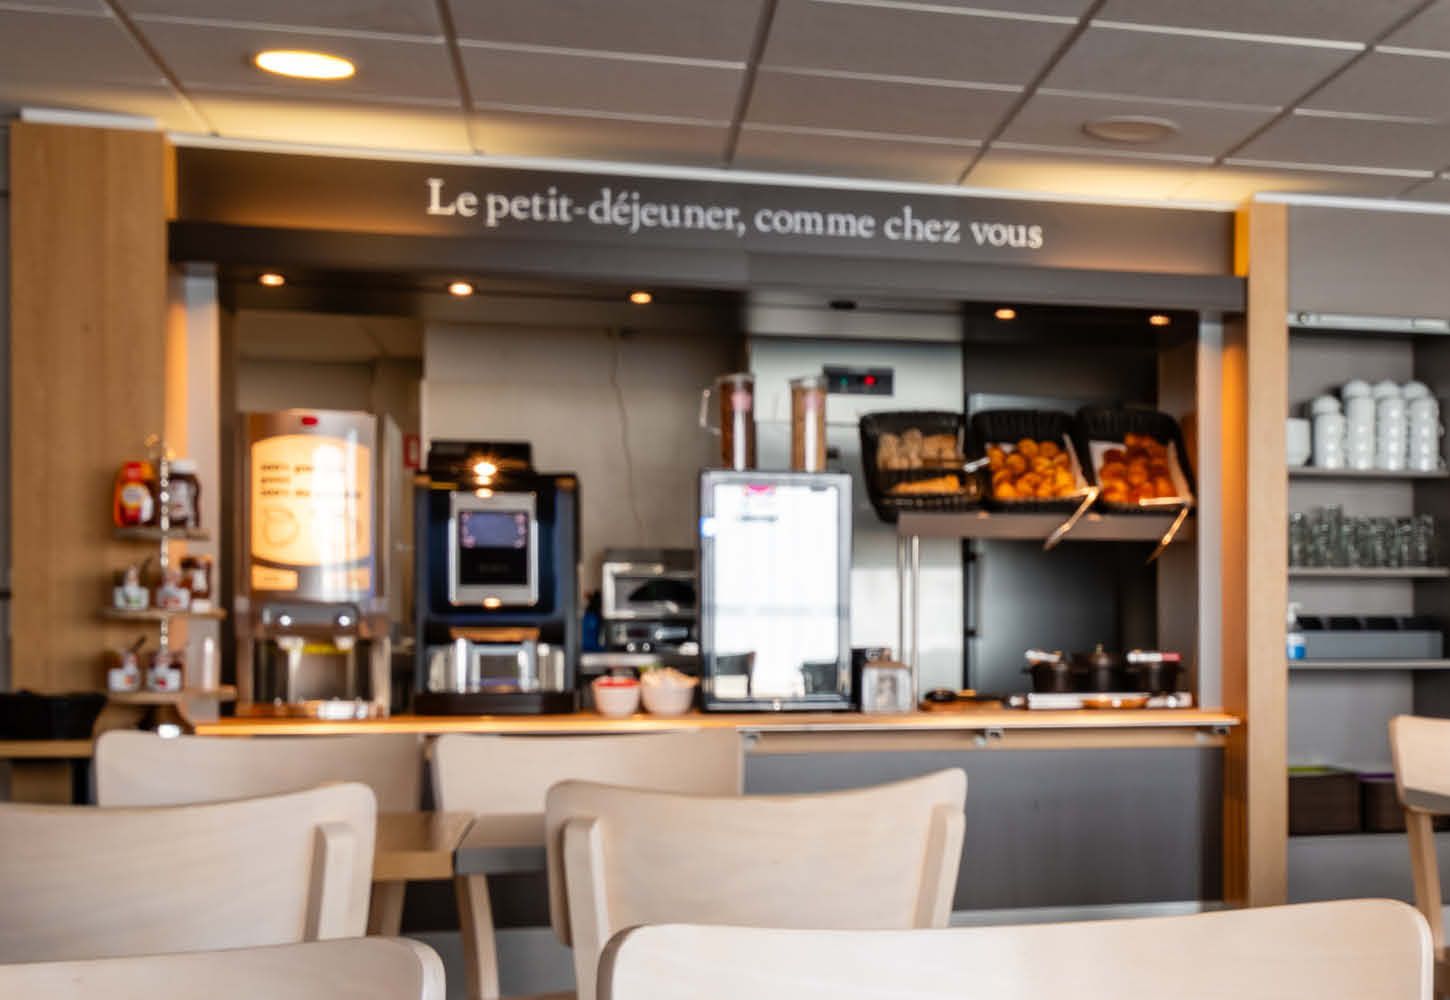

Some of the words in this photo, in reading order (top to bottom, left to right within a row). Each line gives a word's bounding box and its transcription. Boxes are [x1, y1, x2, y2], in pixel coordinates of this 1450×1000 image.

[427, 177, 478, 217] Le
[484, 186, 746, 237] petit-déjeuner,
[754, 208, 876, 238] comme
[884, 205, 961, 243] chez
[969, 221, 1043, 249] vous
